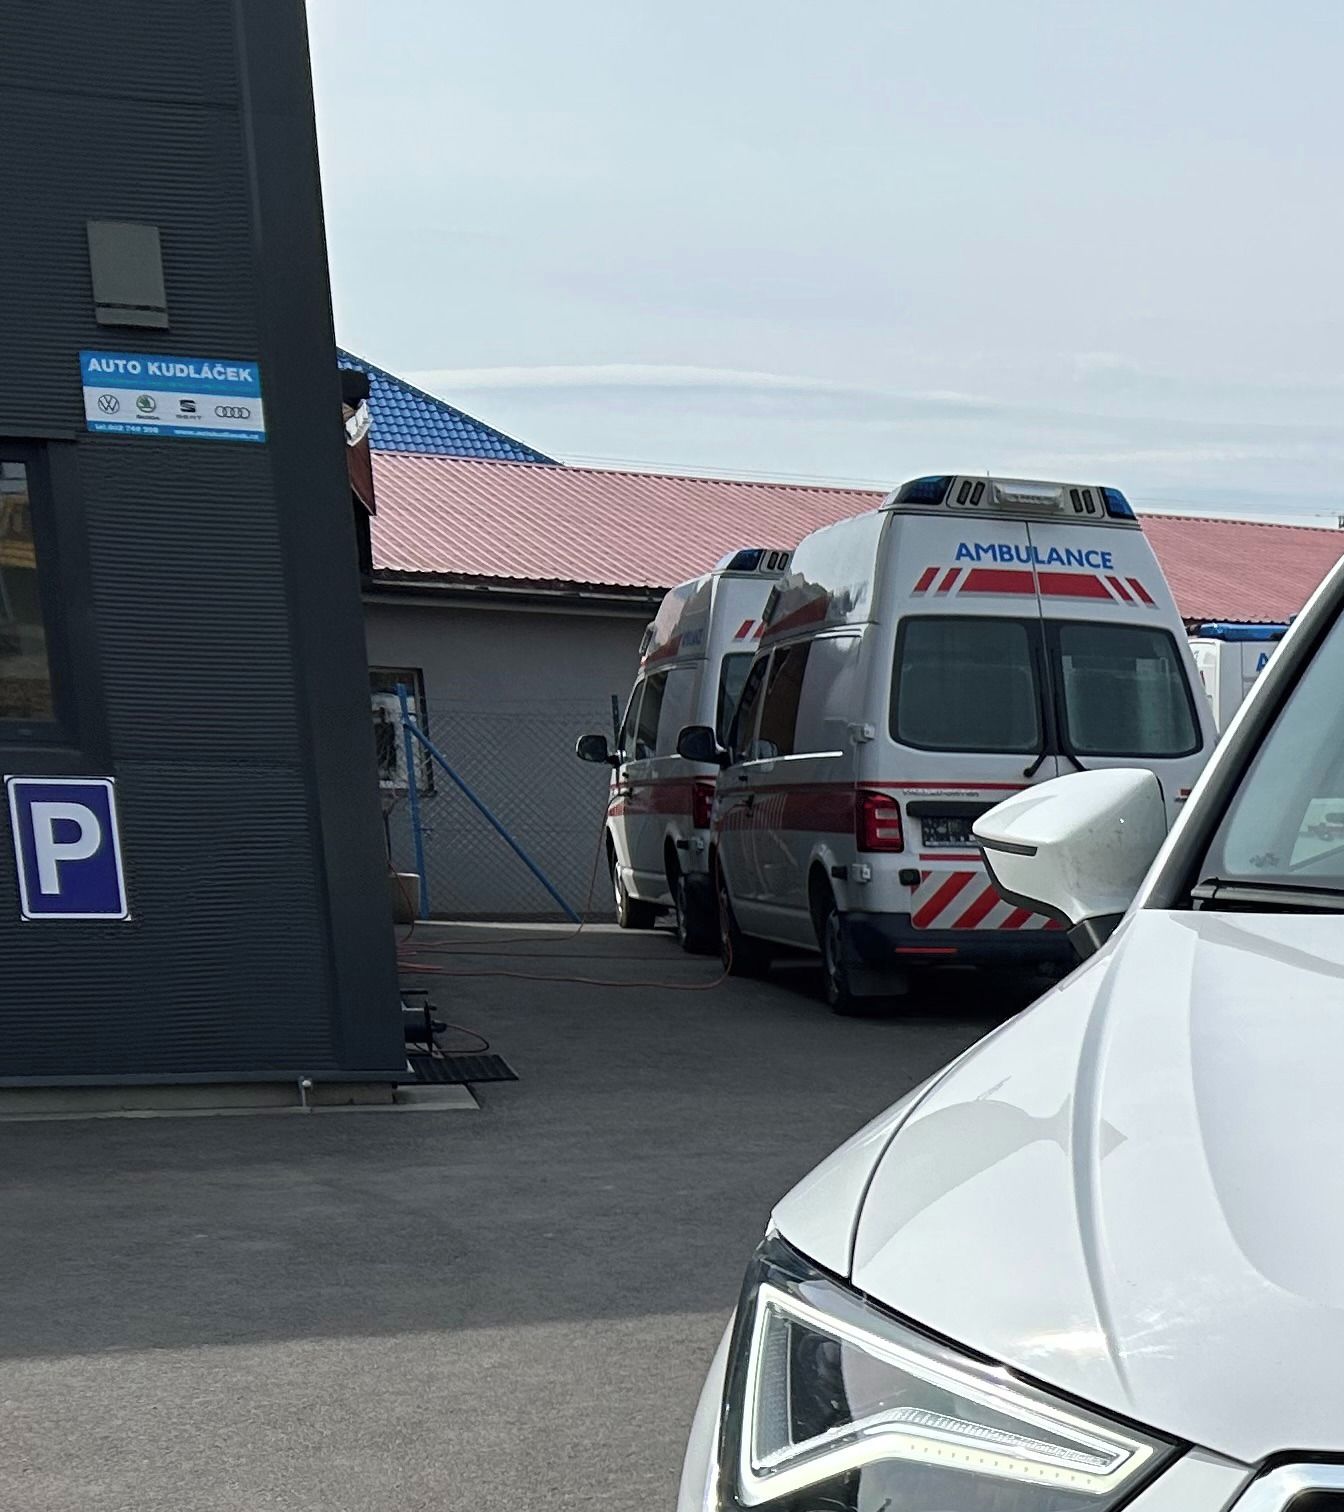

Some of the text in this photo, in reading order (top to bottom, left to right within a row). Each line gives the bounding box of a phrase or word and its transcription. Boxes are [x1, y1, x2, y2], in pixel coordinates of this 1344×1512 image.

[88, 358, 253, 382] AUTO KUDLÁČEK
[955, 542, 1114, 570] AMBULANCE
[30, 801, 101, 895] P
